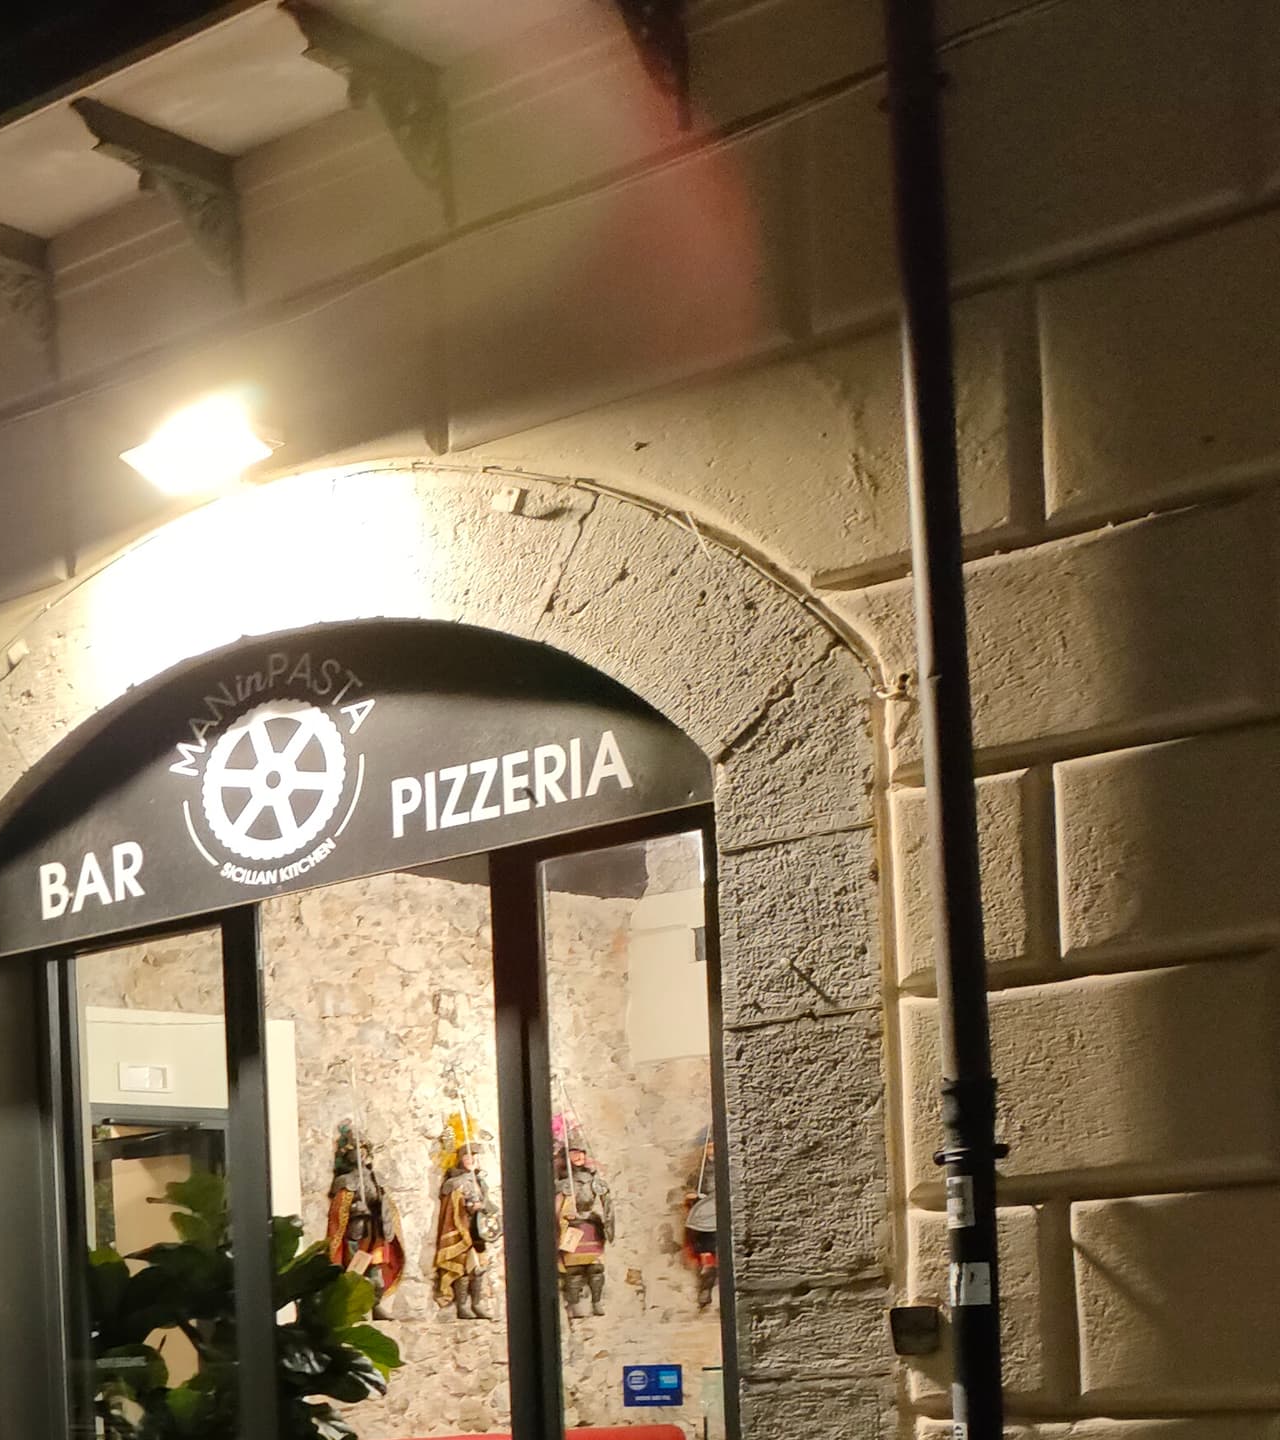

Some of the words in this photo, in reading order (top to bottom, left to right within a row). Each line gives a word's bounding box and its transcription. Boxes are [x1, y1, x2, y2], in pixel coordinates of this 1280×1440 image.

[169, 653, 376, 777] MANinPASTA
[391, 731, 634, 838] PIZZERIA
[40, 840, 145, 920] BAR
[220, 861, 278, 885] SICILIAN
[279, 837, 337, 883] KITCHEN
